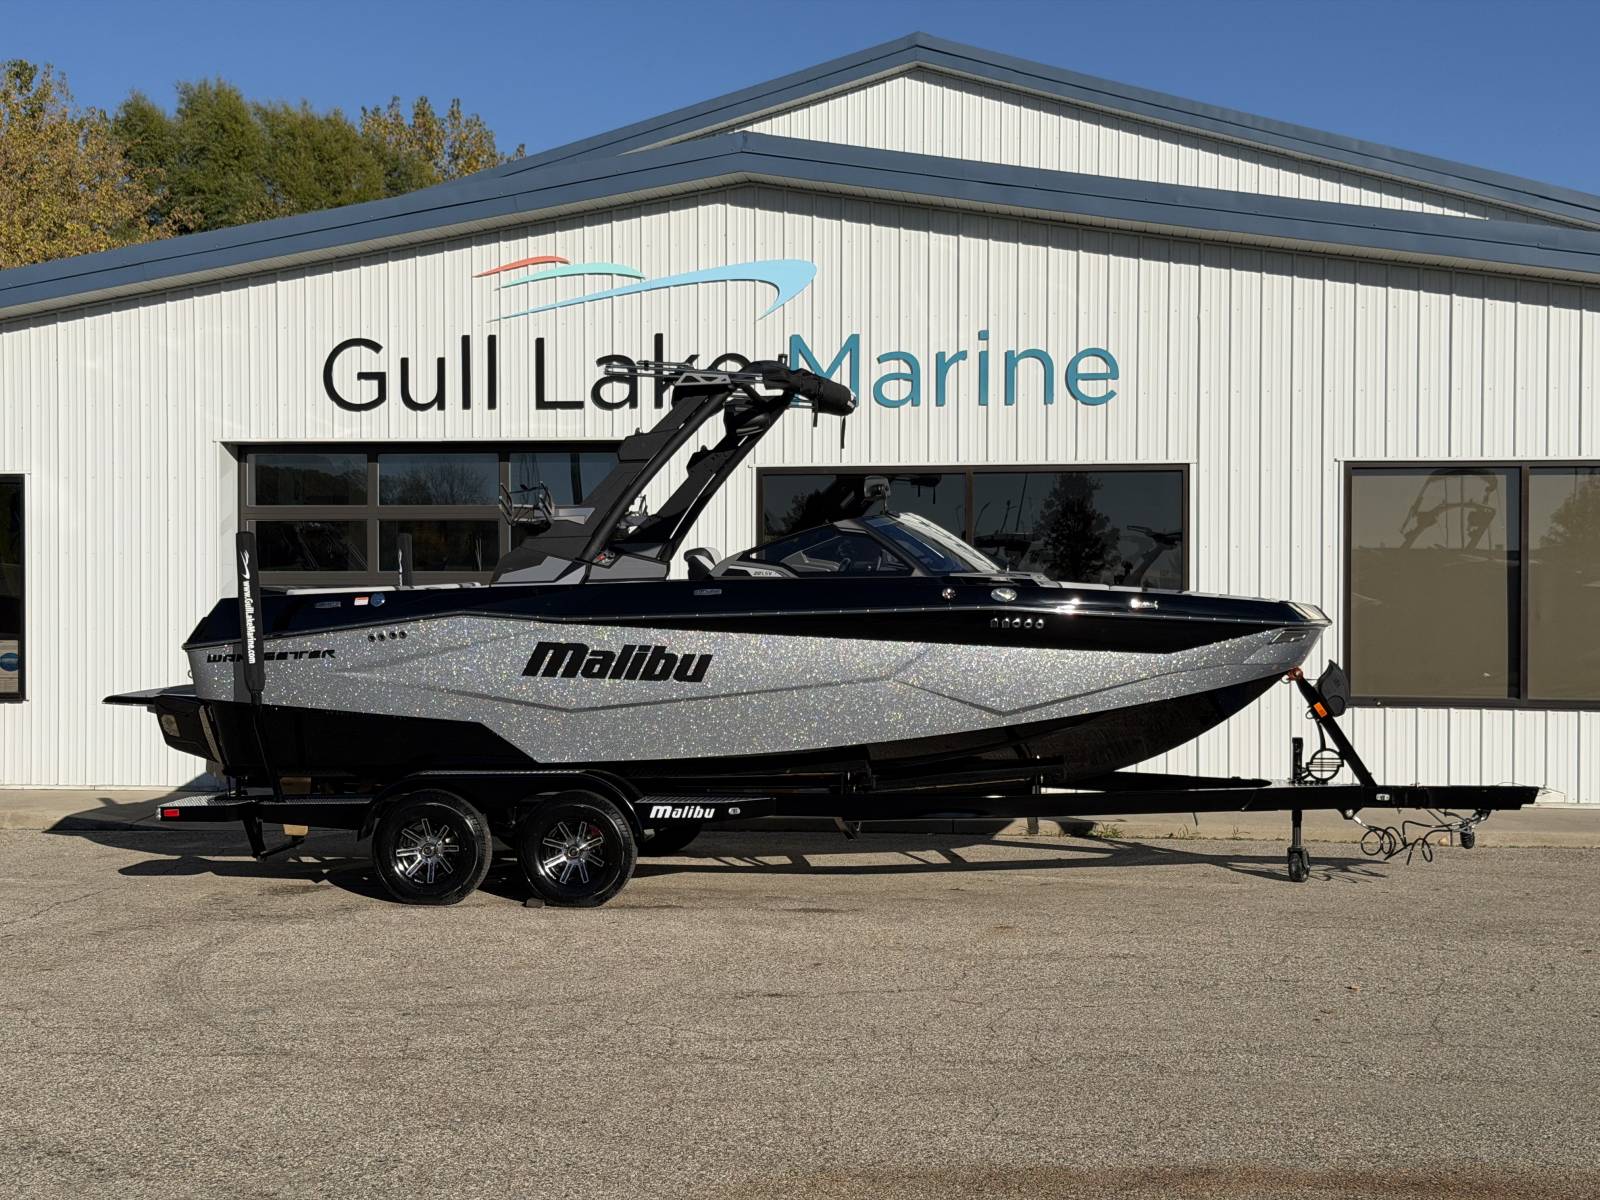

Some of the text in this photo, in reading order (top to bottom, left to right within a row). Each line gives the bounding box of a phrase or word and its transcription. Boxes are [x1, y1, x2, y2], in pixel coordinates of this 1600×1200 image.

[323, 334, 497, 412] Gull
[788, 329, 1120, 408] Marine
[243, 580, 257, 664] www.GullLakeMarine.com
[521, 641, 714, 682] Malibu
[649, 805, 716, 819] Malibu
